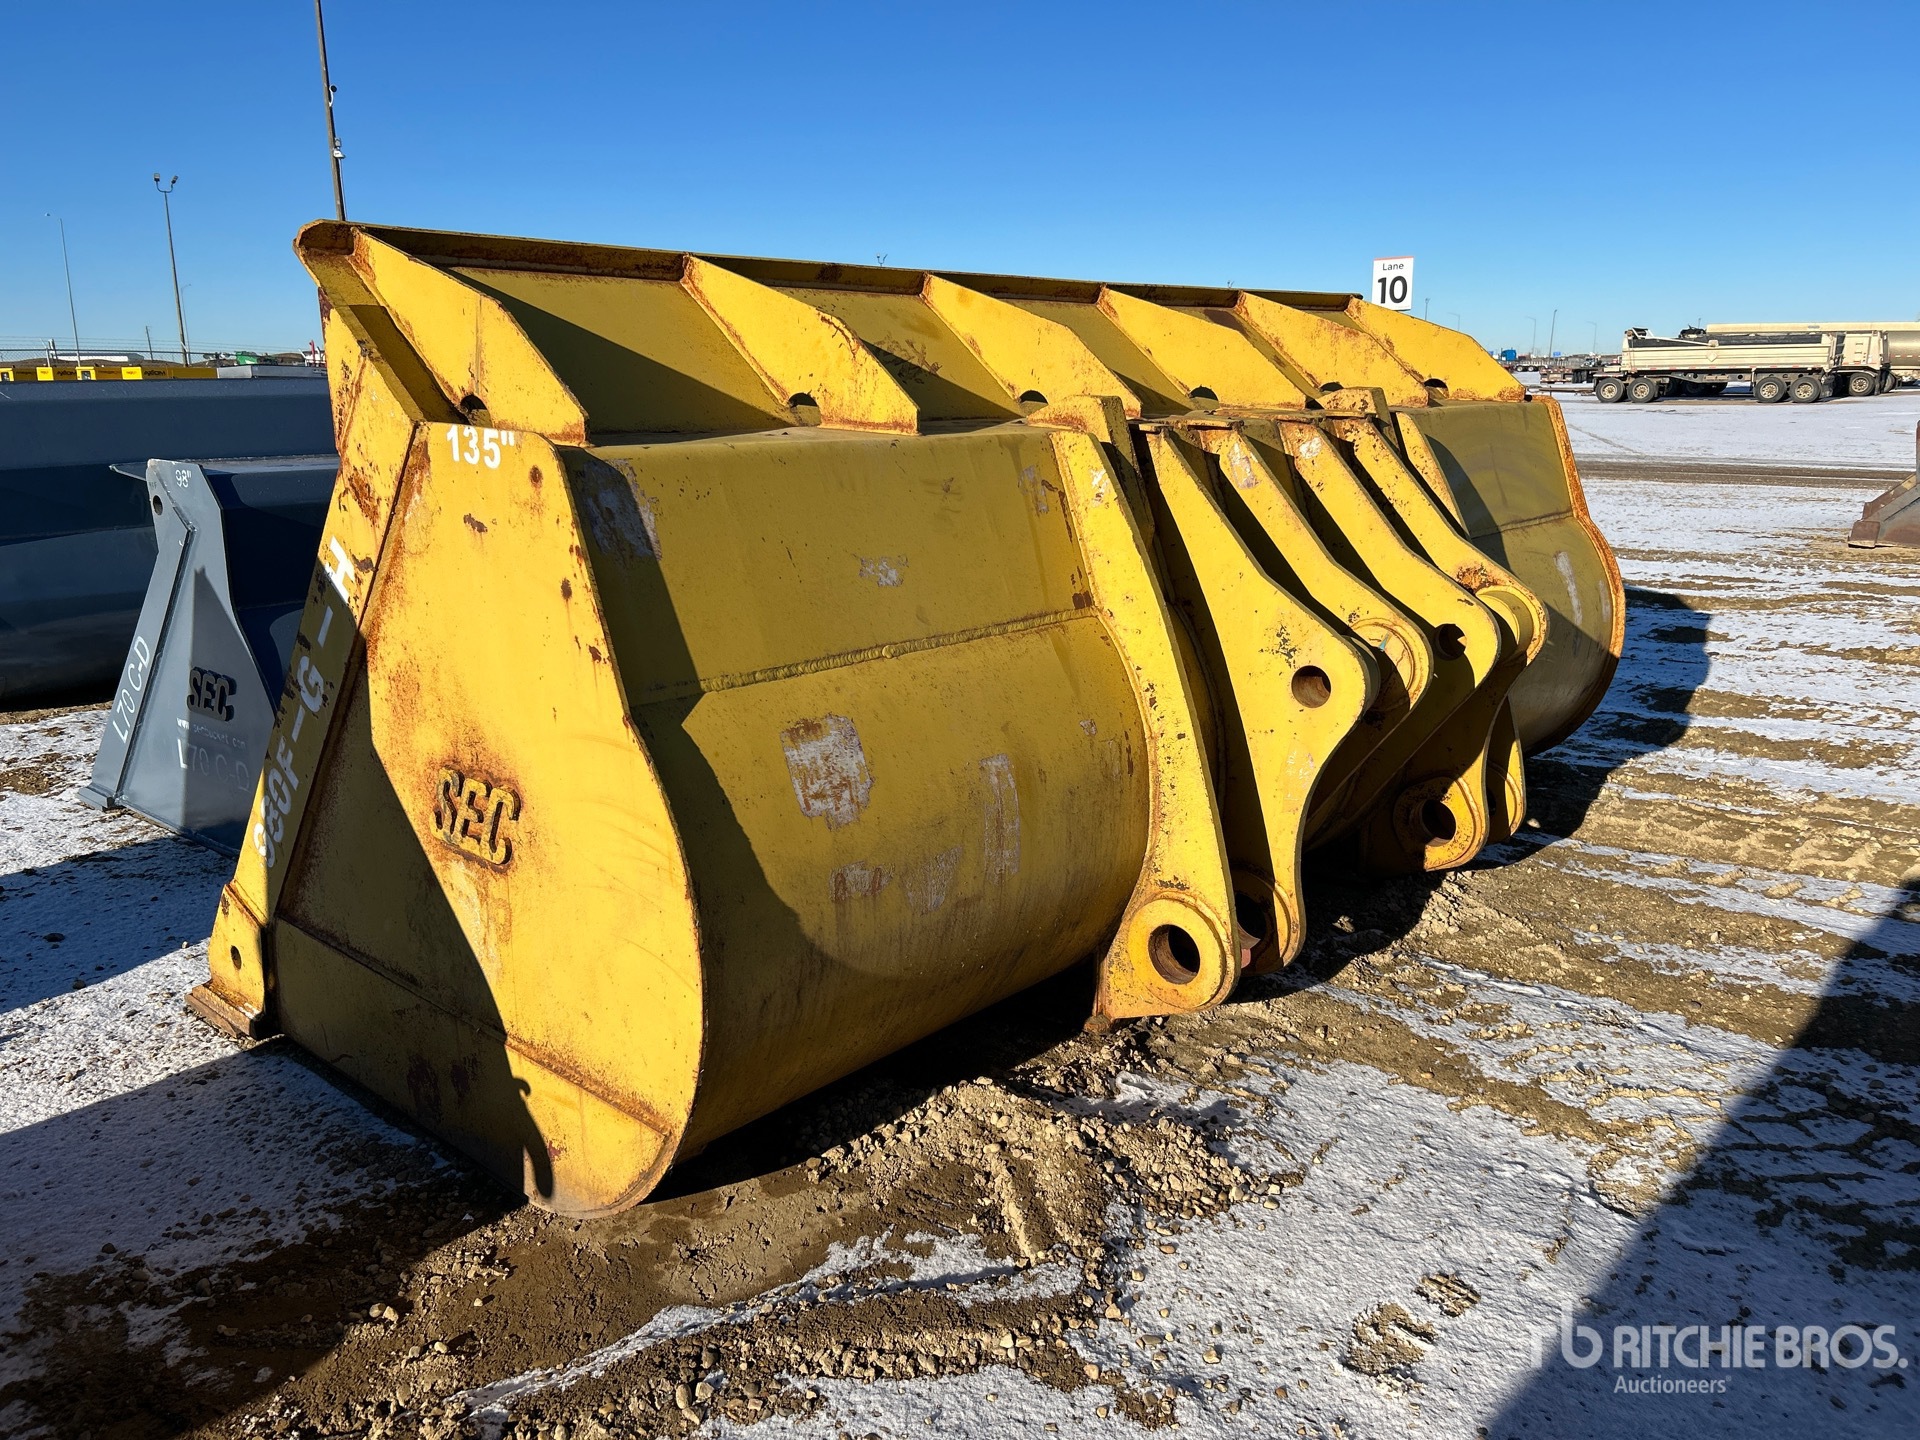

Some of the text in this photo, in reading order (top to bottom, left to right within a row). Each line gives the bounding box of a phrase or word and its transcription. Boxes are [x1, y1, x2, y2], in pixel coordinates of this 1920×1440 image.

[1382, 263, 1404, 271] Lane
[1377, 275, 1408, 304] 10
[446, 423, 515, 469] 135"
[175, 469, 192, 488] 98"
[112, 635, 150, 744] L70 C-D
[187, 666, 237, 722] SEC
[177, 738, 210, 776] L70
[429, 765, 521, 866] SEC
